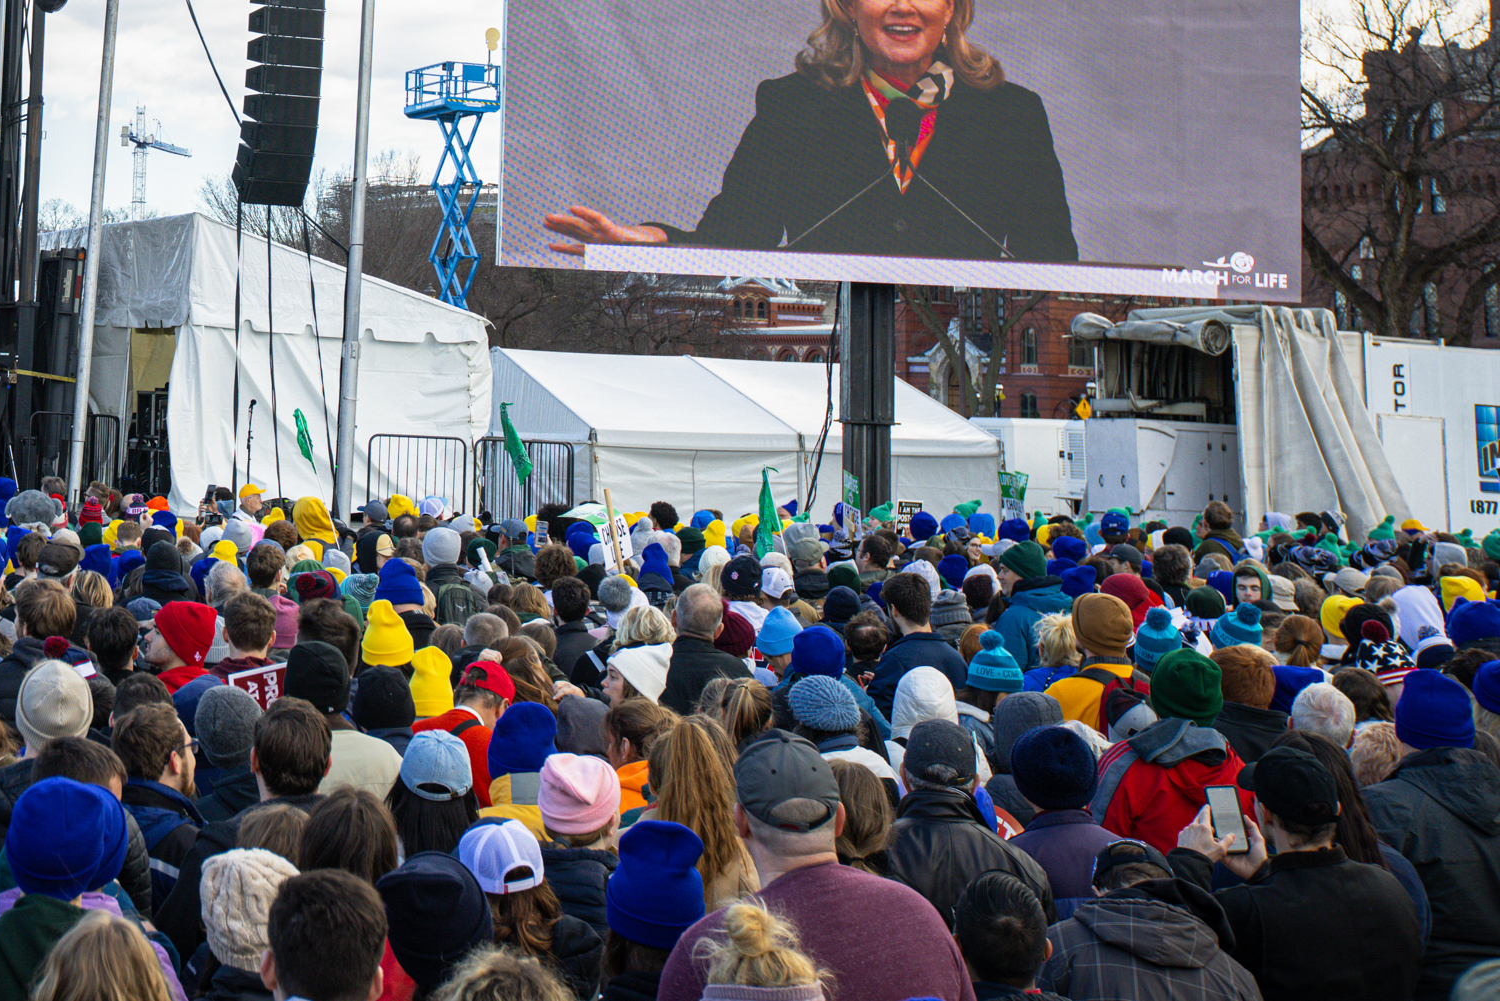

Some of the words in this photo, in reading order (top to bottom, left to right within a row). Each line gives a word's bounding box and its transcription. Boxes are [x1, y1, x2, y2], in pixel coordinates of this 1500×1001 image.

[1161, 268, 1229, 286] MARCH
[1231, 274, 1251, 285] FOR
[1254, 273, 1288, 289] LIFE
[975, 666, 995, 677] LOVE
